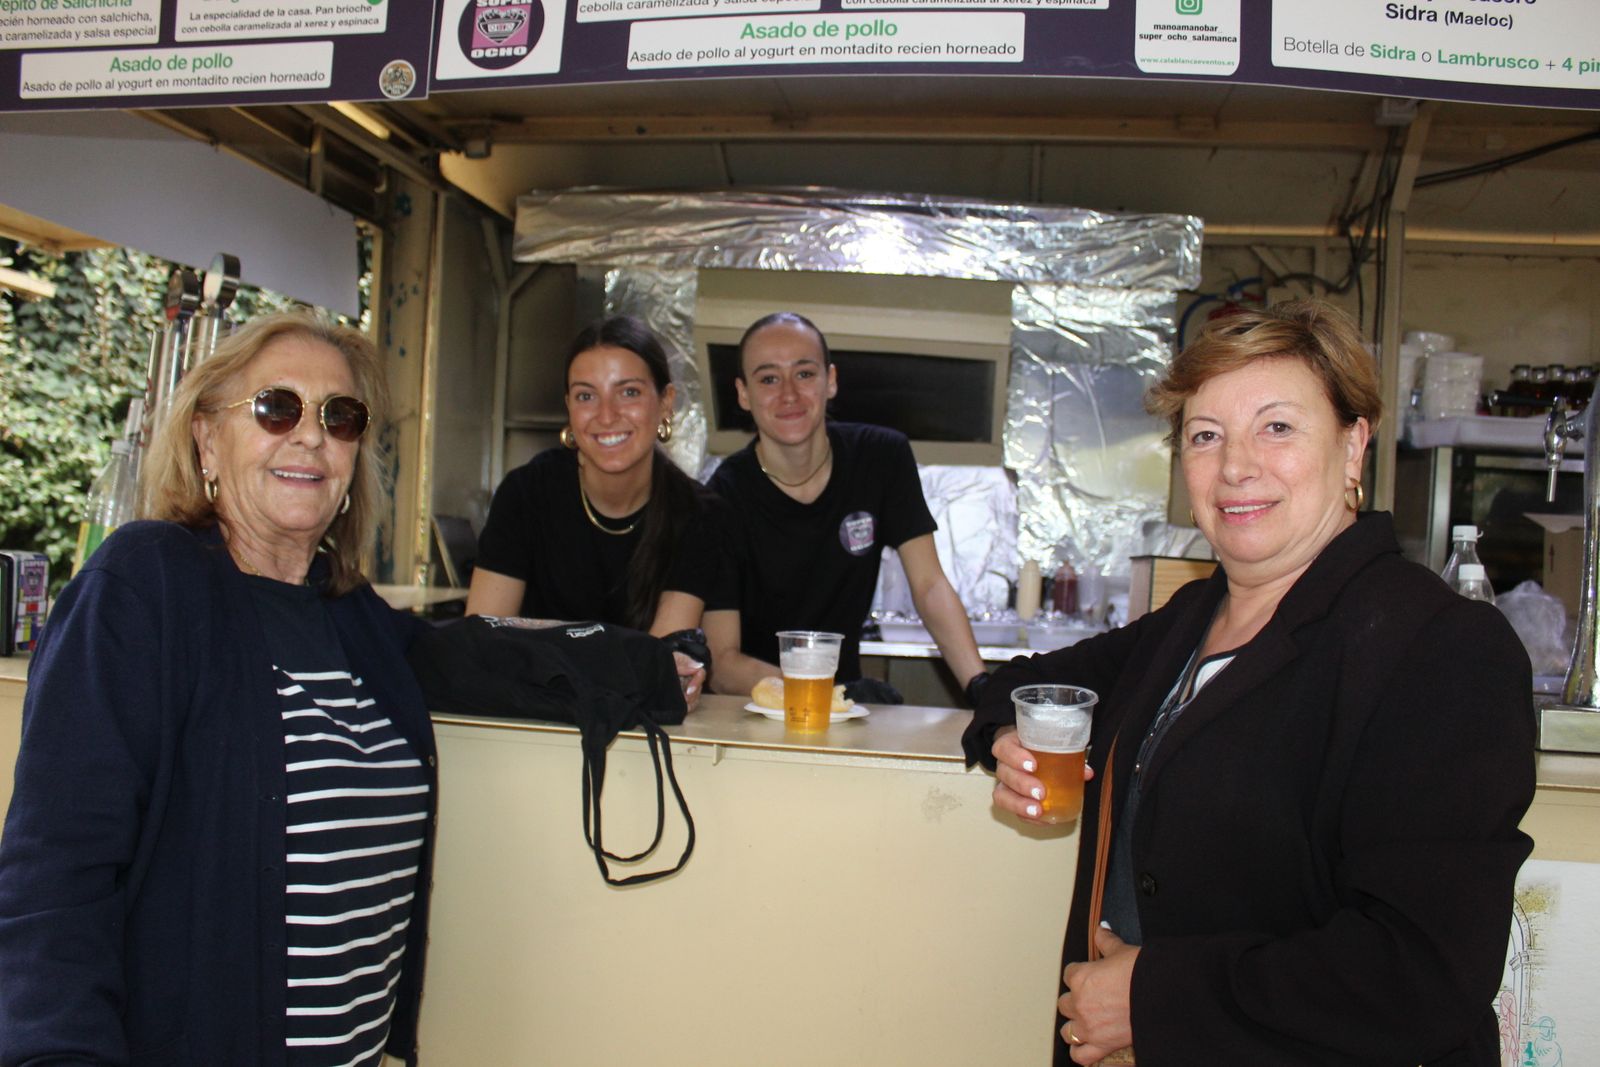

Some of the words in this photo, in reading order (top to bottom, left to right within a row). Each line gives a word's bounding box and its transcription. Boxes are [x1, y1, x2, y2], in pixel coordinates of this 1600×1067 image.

[0, 0, 37, 14] epito
[40, 0, 58, 10] de
[204, 10, 261, 21] especialidad
[263, 9, 275, 17] de
[277, 8, 286, 16] la
[287, 7, 314, 16] casa.
[315, 5, 334, 15] Pan
[336, 4, 373, 14] brioche
[579, 2, 623, 12] cebolla
[27, 14, 76, 25] horneado
[79, 15, 97, 24] con
[1385, 3, 1438, 22] Sidra
[1444, 10, 1514, 30] (Maeloc)
[6, 30, 72, 41] caramelizada
[75, 31, 80, 40] y
[84, 28, 110, 38] salsa
[113, 26, 156, 37] especial
[181, 26, 198, 34] con
[200, 23, 231, 33] cebolla
[234, 21, 292, 31] caramelizada
[293, 19, 302, 29] al
[304, 19, 330, 28] xerez
[330, 20, 336, 28] y
[339, 17, 380, 27] espinaca
[740, 22, 807, 40] Asado
[813, 20, 839, 37] de
[845, 19, 898, 40] pollo
[471, 46, 527, 58] OCHO
[630, 51, 672, 63] Asado
[676, 49, 693, 60] de
[697, 47, 730, 61] pollo
[734, 47, 746, 58] al
[750, 45, 795, 59] yogurt
[799, 47, 816, 56] en
[820, 43, 893, 55] montadito
[897, 43, 941, 55] recien
[946, 43, 1016, 55] horneado
[1283, 37, 1339, 55] Botella
[1344, 42, 1365, 57] de
[1370, 43, 1416, 61] Sidra
[1421, 51, 1432, 62] o
[1437, 49, 1539, 70] Lambrusco
[1562, 57, 1573, 72] 4
[110, 57, 162, 73] Asado
[167, 55, 188, 70] de
[192, 54, 233, 72] pollo
[23, 80, 56, 92] Asado
[59, 80, 73, 91] de
[76, 79, 102, 92] pollo
[105, 78, 115, 89] al
[117, 76, 153, 90] yogurt
[156, 78, 169, 87] en
[172, 73, 229, 87] montadito
[232, 72, 267, 84] recien
[270, 71, 325, 83] horneado
